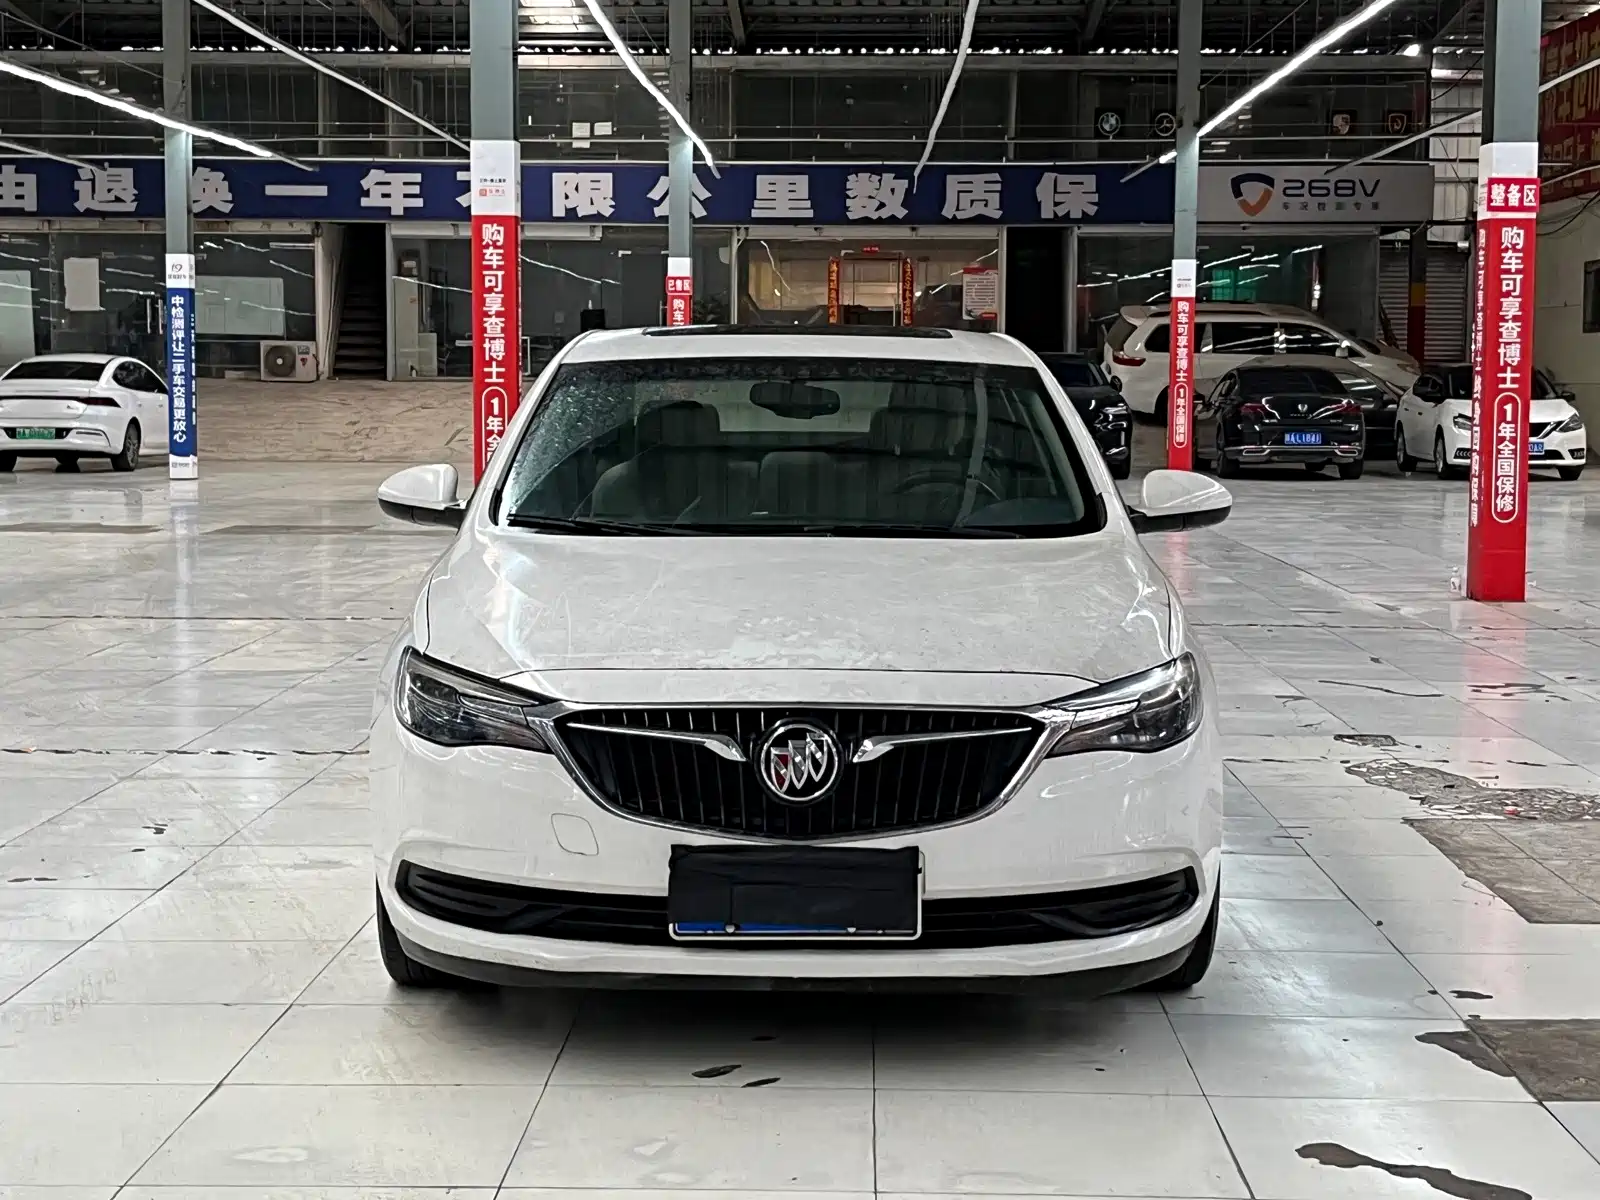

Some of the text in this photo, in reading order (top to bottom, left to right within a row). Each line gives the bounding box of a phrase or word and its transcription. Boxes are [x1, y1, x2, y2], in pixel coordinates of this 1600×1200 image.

[1282, 178, 1381, 198] 268V
[1490, 183, 1537, 207] 整备区
[481, 223, 504, 383] 购车可享查博士
[673, 299, 685, 325] 购车
[1497, 226, 1525, 389] 购车可享查博士
[486, 397, 503, 462] 1年全
[1496, 403, 1516, 513] 1年全国保修
